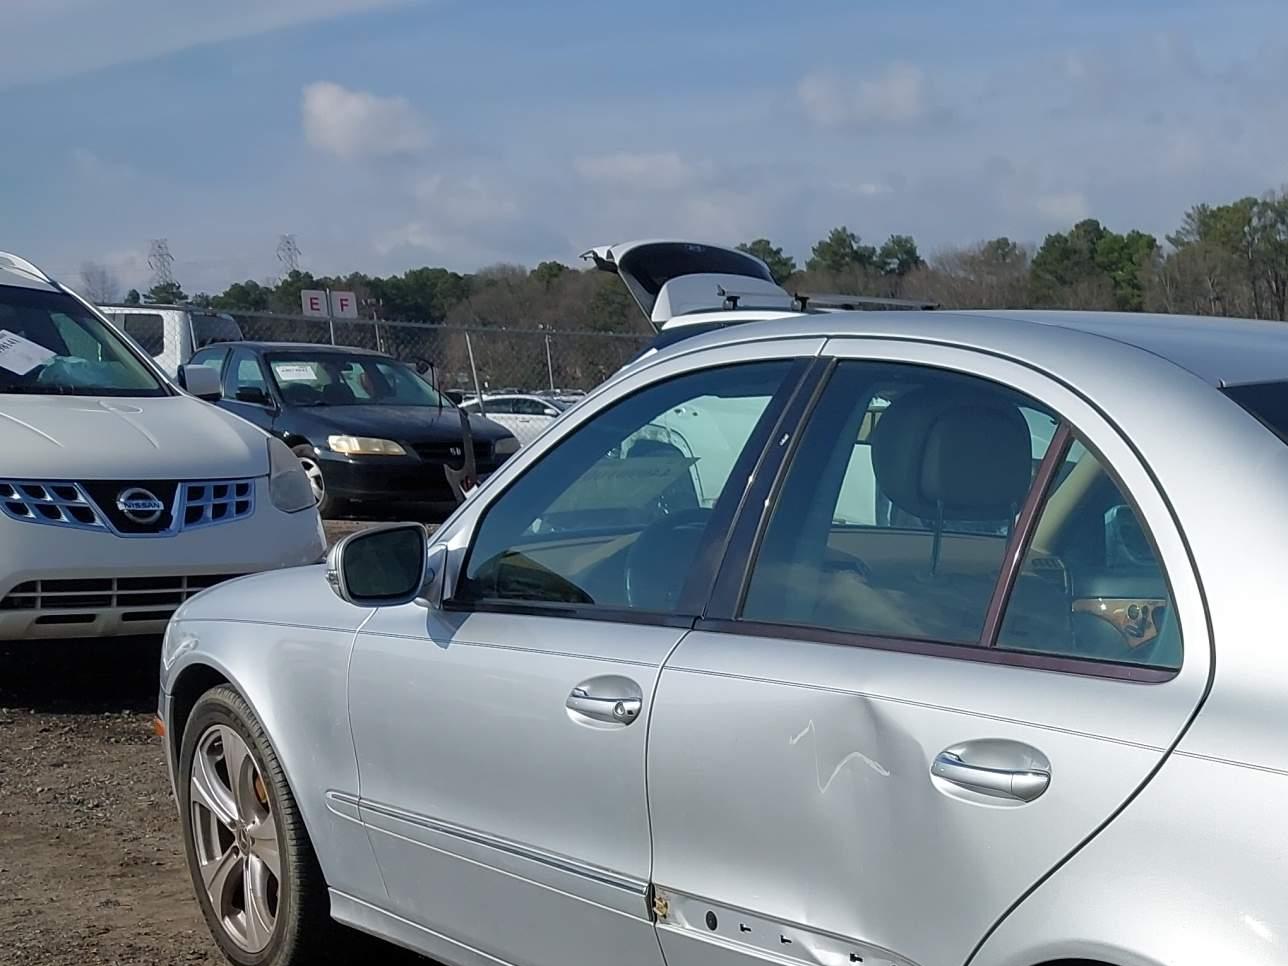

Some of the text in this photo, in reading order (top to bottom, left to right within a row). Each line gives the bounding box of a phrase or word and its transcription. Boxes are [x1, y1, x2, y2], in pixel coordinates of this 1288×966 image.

[310, 297, 320, 311] E
[340, 298, 349, 312] F
[122, 501, 161, 510] NISSAN
